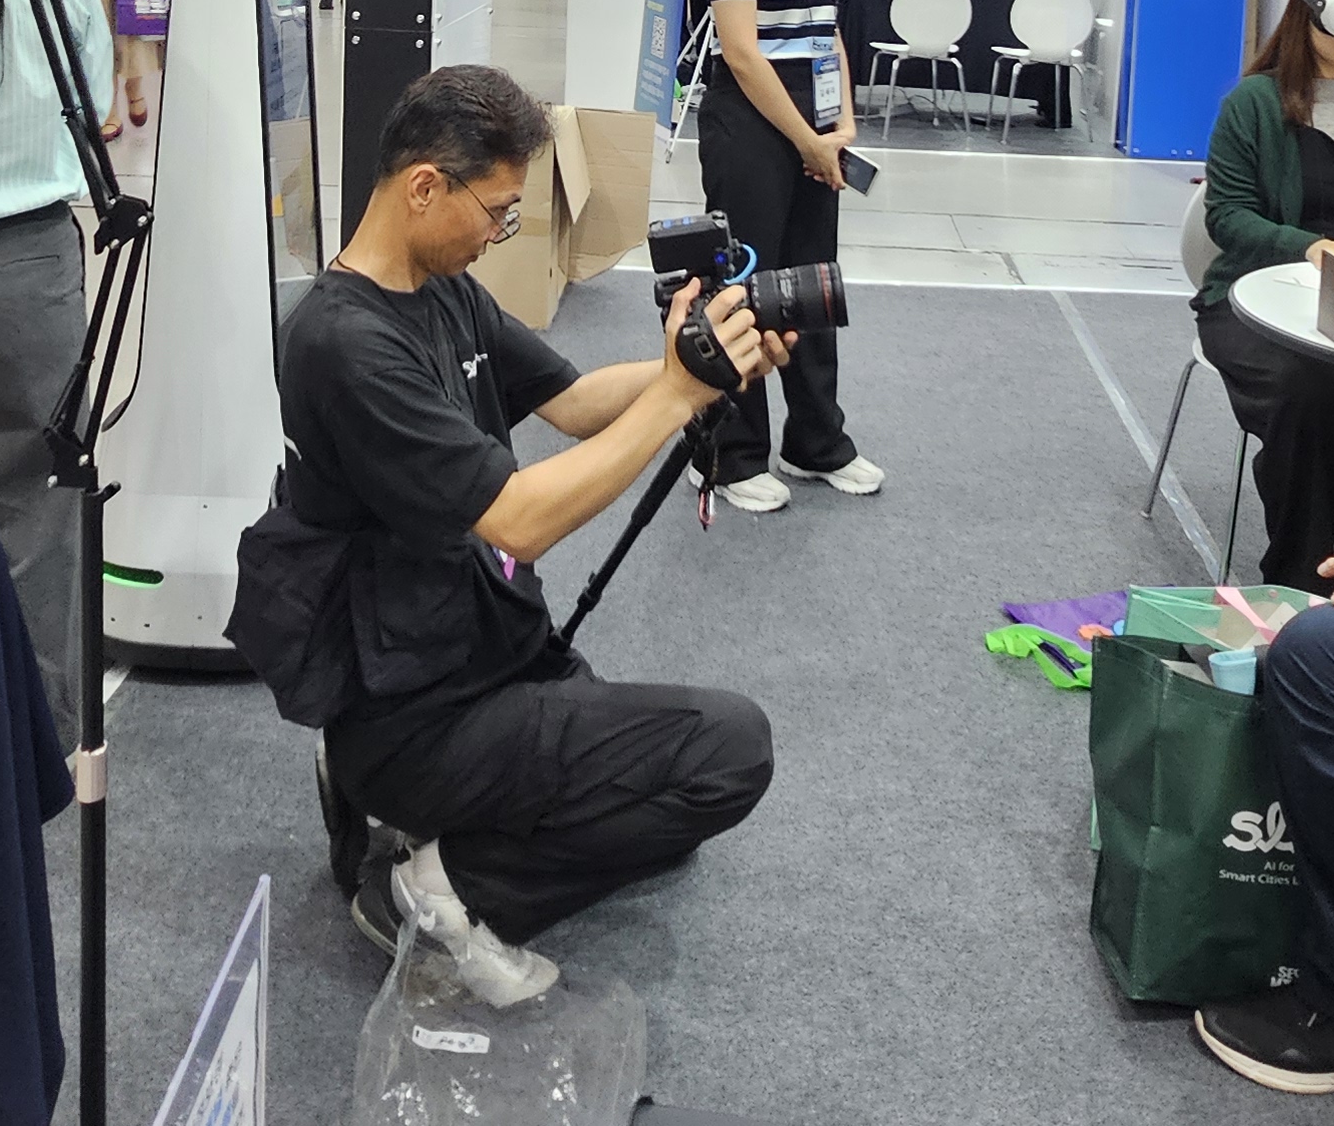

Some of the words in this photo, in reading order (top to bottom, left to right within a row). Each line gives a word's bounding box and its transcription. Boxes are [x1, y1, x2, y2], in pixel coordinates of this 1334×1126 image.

[1263, 861, 1276, 872] AI
[1278, 861, 1295, 872] for
[1219, 869, 1255, 884] Smart
[1258, 873, 1289, 886] Cities
